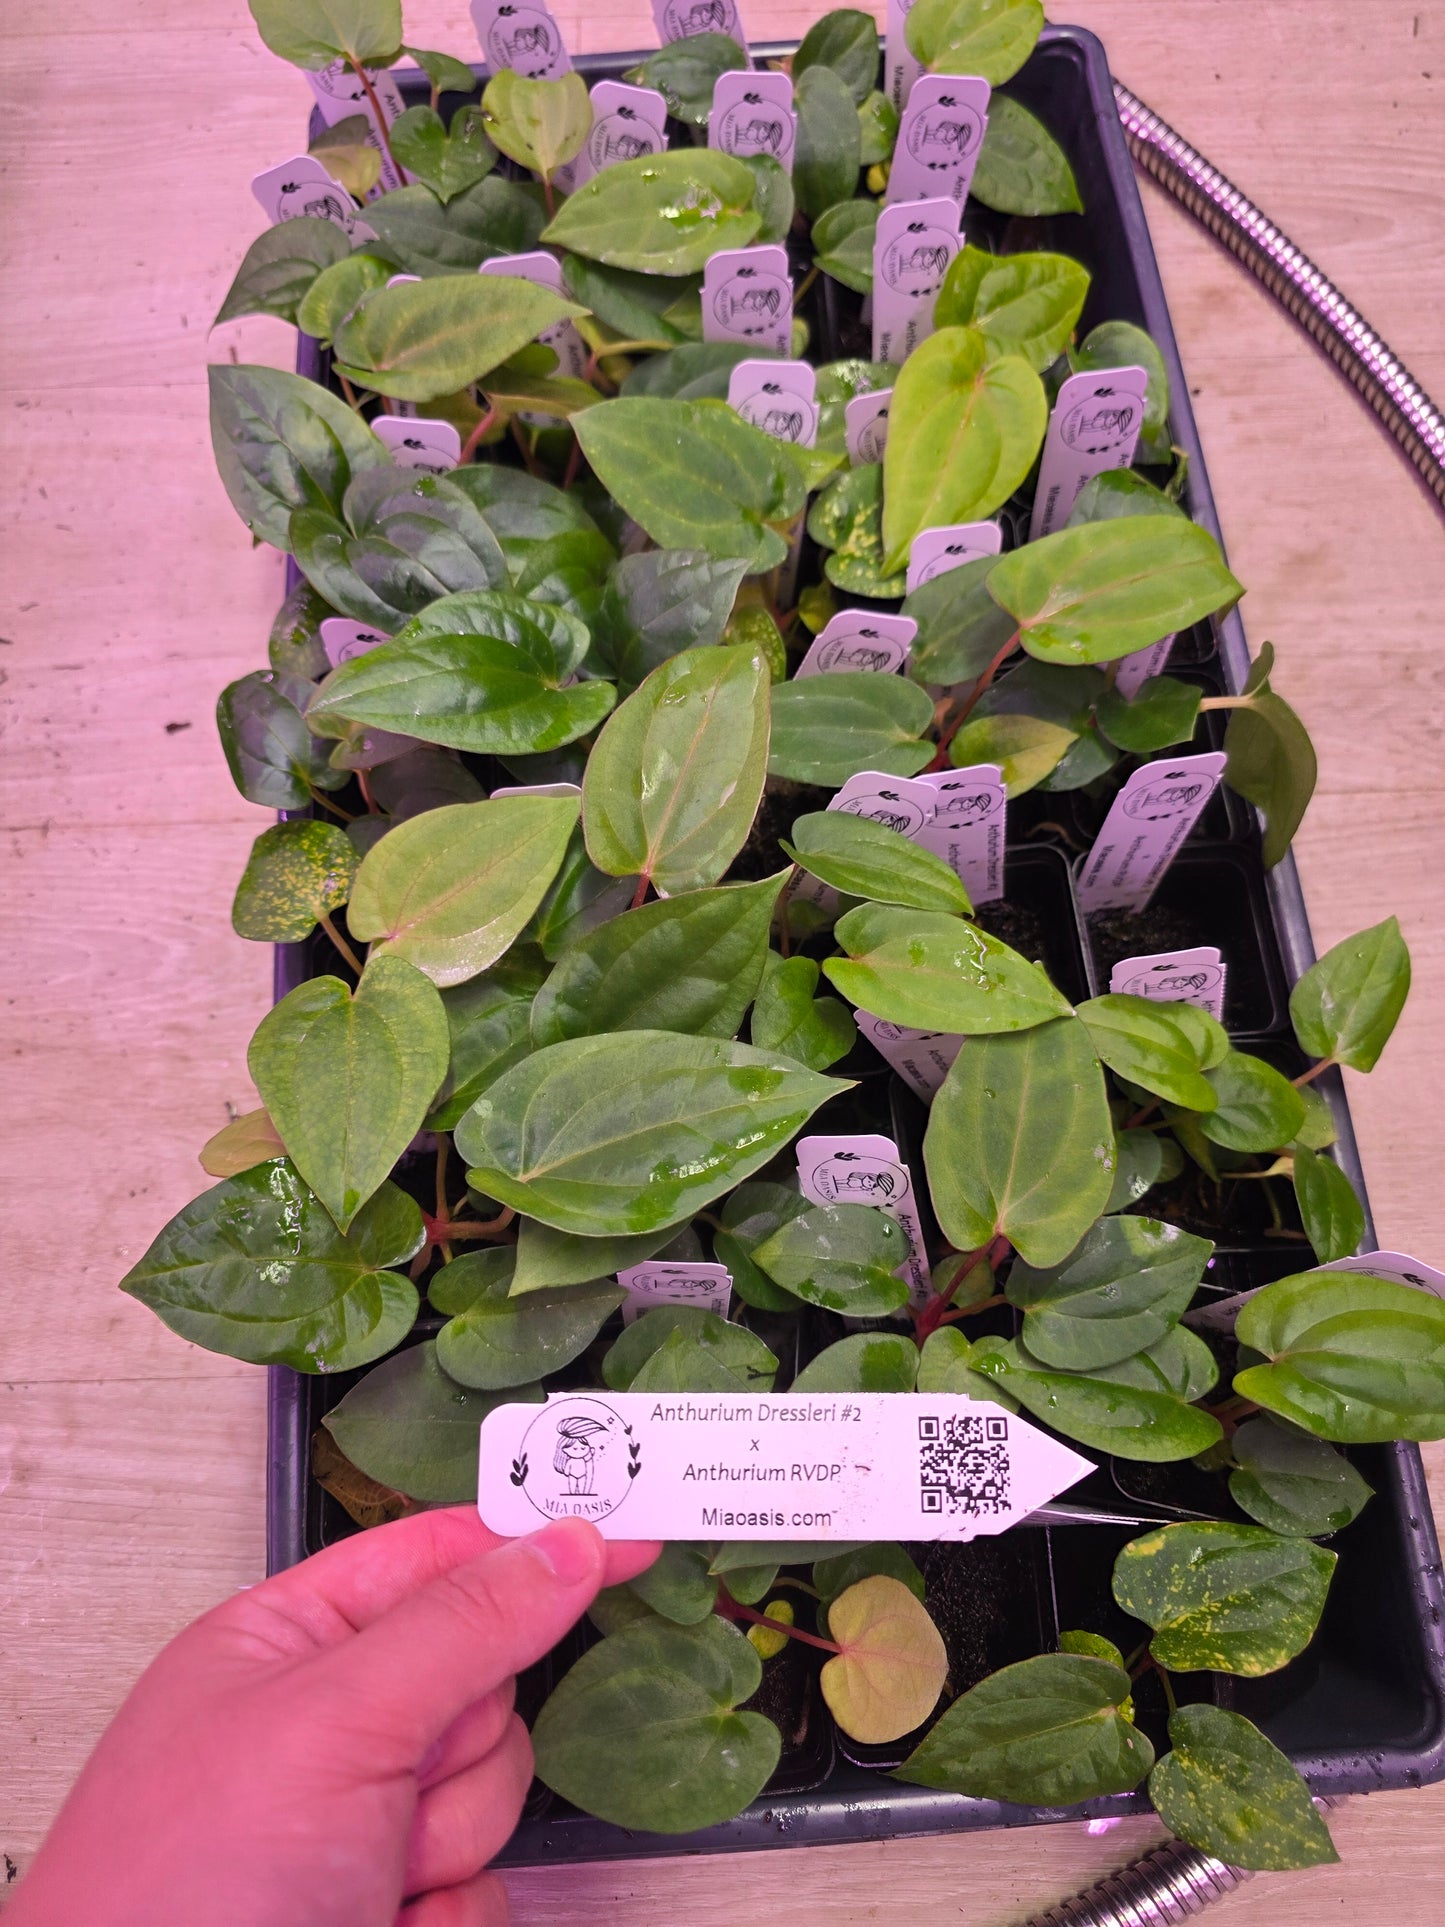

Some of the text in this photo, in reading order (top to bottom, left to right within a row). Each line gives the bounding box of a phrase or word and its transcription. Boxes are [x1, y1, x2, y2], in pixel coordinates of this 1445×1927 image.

[650, 1402, 861, 1421] Anthurium Dressleri #2
[750, 1439, 760, 1451] x
[682, 1462, 841, 1481] Anthurium RVDP
[543, 1498, 613, 1515] MIA OASIS
[702, 1508, 831, 1526] Miaoasis.com
